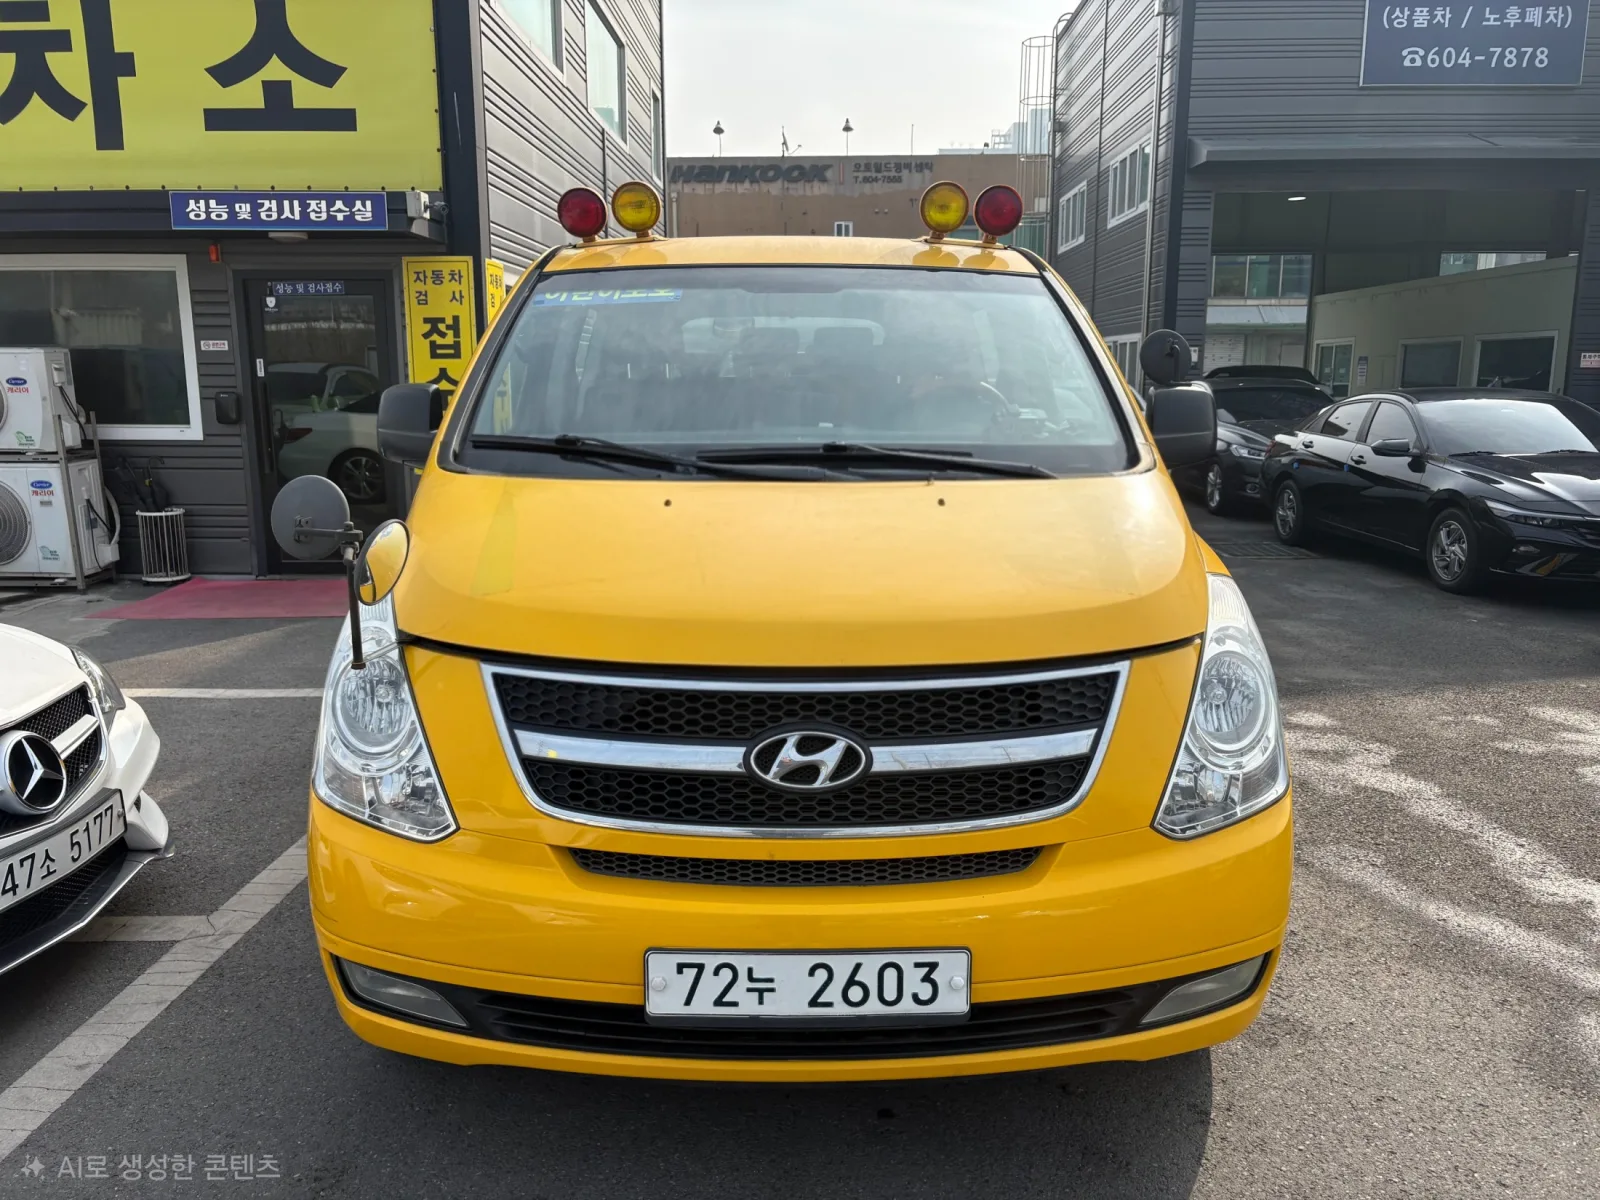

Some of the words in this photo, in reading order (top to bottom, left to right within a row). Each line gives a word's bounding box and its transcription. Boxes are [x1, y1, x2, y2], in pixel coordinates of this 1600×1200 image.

[1383, 6, 1452, 28] (상품차
[1482, 6, 1573, 28] 노후폐차)
[1427, 47, 1549, 68] 604-7878
[185, 199, 229, 221] 성능
[235, 203, 252, 220] 및
[257, 199, 301, 221] 검사
[306, 199, 373, 221] 접수실
[276, 282, 294, 294] 성능
[296, 282, 305, 294] 및
[413, 269, 463, 286] 자동차
[1, 848, 57, 896] 47소
[69, 803, 115, 864] 5177
[676, 961, 776, 1008] 72누
[807, 961, 940, 1008] 2603
